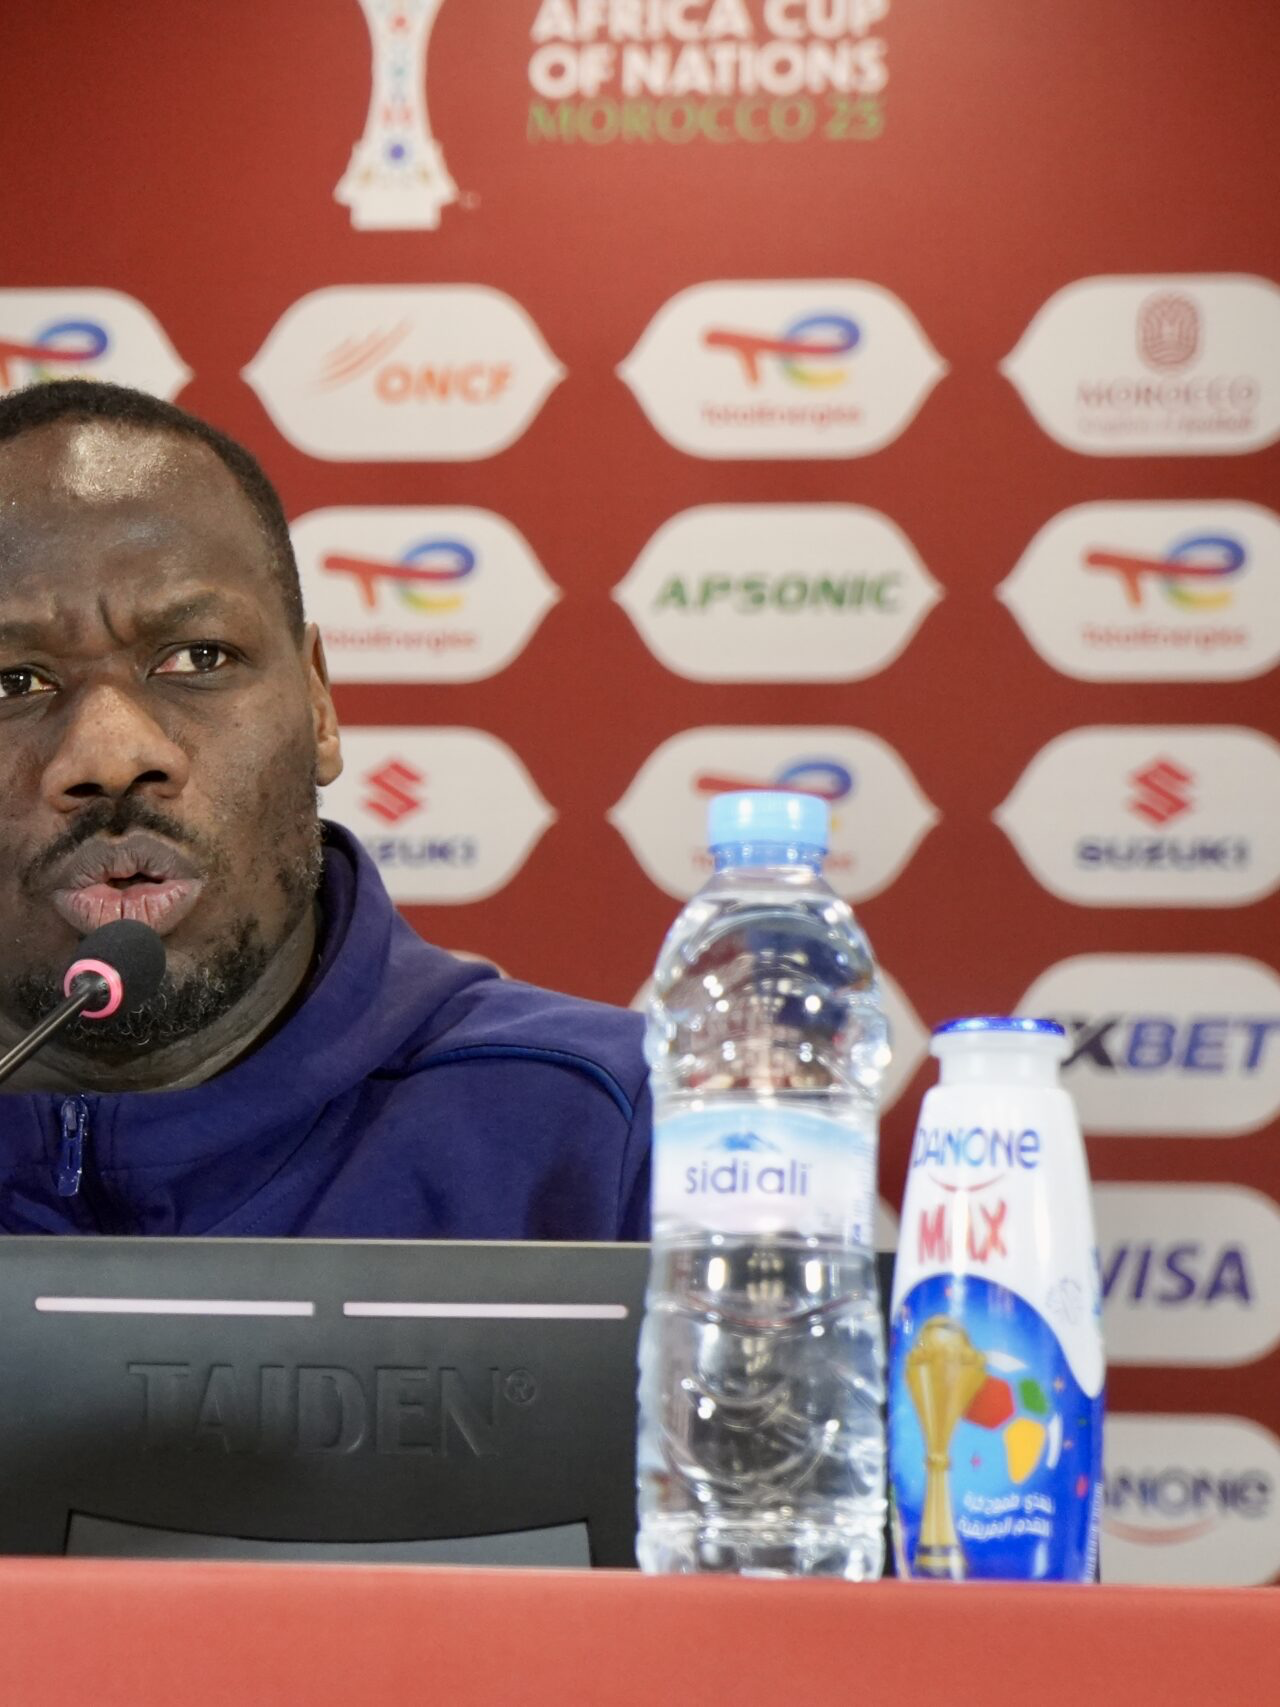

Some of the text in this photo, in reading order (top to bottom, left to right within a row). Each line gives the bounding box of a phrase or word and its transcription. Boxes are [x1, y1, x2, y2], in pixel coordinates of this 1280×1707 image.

[531, 0, 889, 41] AFRICA CUP
[528, 40, 888, 99] OF NATIONS
[527, 96, 885, 144] MOROCCO 25
[374, 363, 513, 405] ONCF
[652, 571, 904, 616] APSONIC
[1075, 837, 1249, 871] SUZUKI
[685, 1158, 809, 1195] sidi ali
